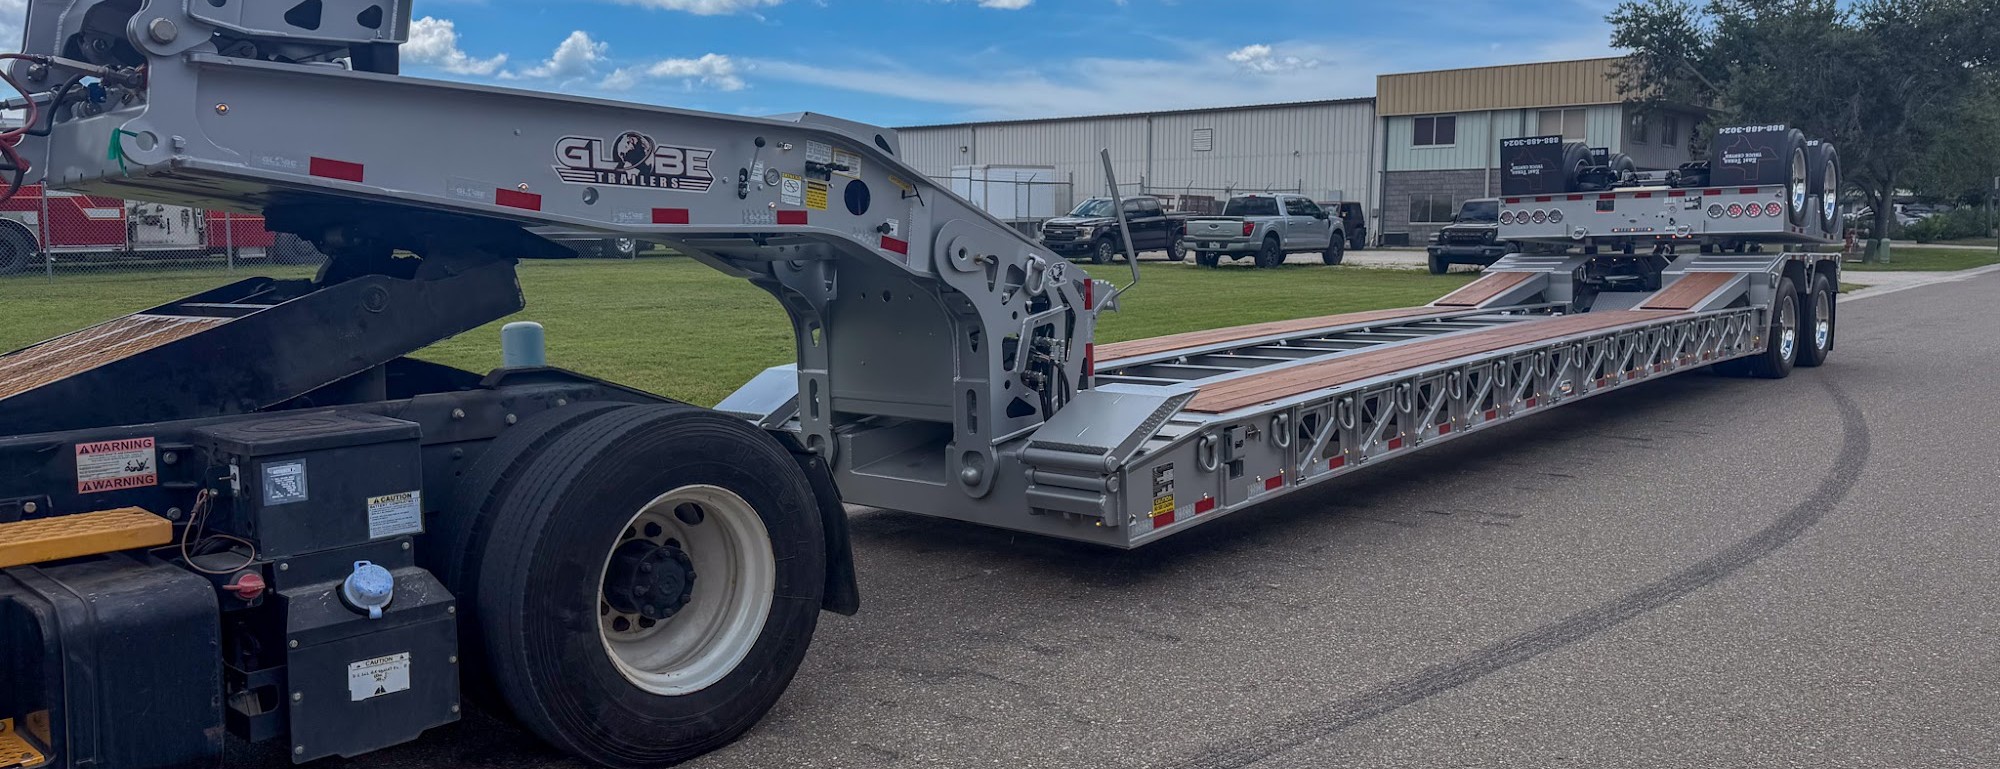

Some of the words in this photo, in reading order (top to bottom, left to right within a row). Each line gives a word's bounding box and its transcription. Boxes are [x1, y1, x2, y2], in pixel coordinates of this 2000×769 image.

[555, 131, 714, 178] GLOBE
[595, 172, 680, 188] TRAILERS
[90, 439, 152, 453] WARNING
[92, 475, 154, 489] WARNING
[380, 493, 412, 503] CAUTION
[365, 656, 394, 667] CAUTION
